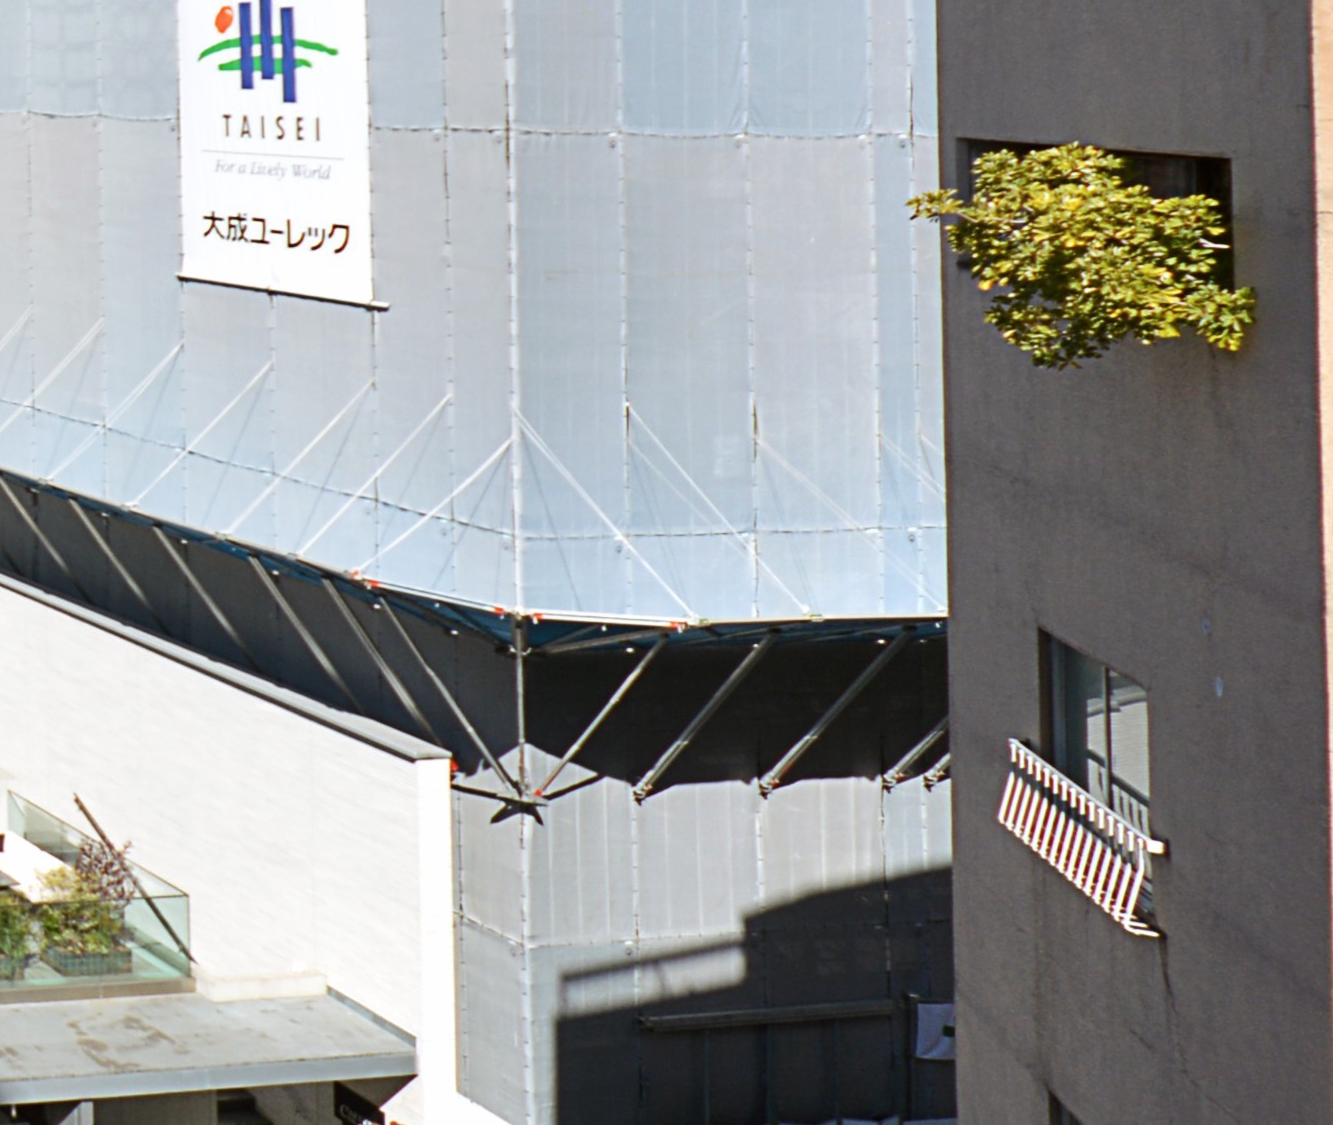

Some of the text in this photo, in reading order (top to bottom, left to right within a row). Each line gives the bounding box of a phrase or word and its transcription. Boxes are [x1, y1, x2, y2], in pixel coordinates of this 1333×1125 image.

[222, 114, 321, 142] TAISEI
[214, 159, 235, 173] For
[237, 163, 248, 175] a
[291, 163, 332, 180] World
[202, 210, 350, 255] 大成ユーレック
